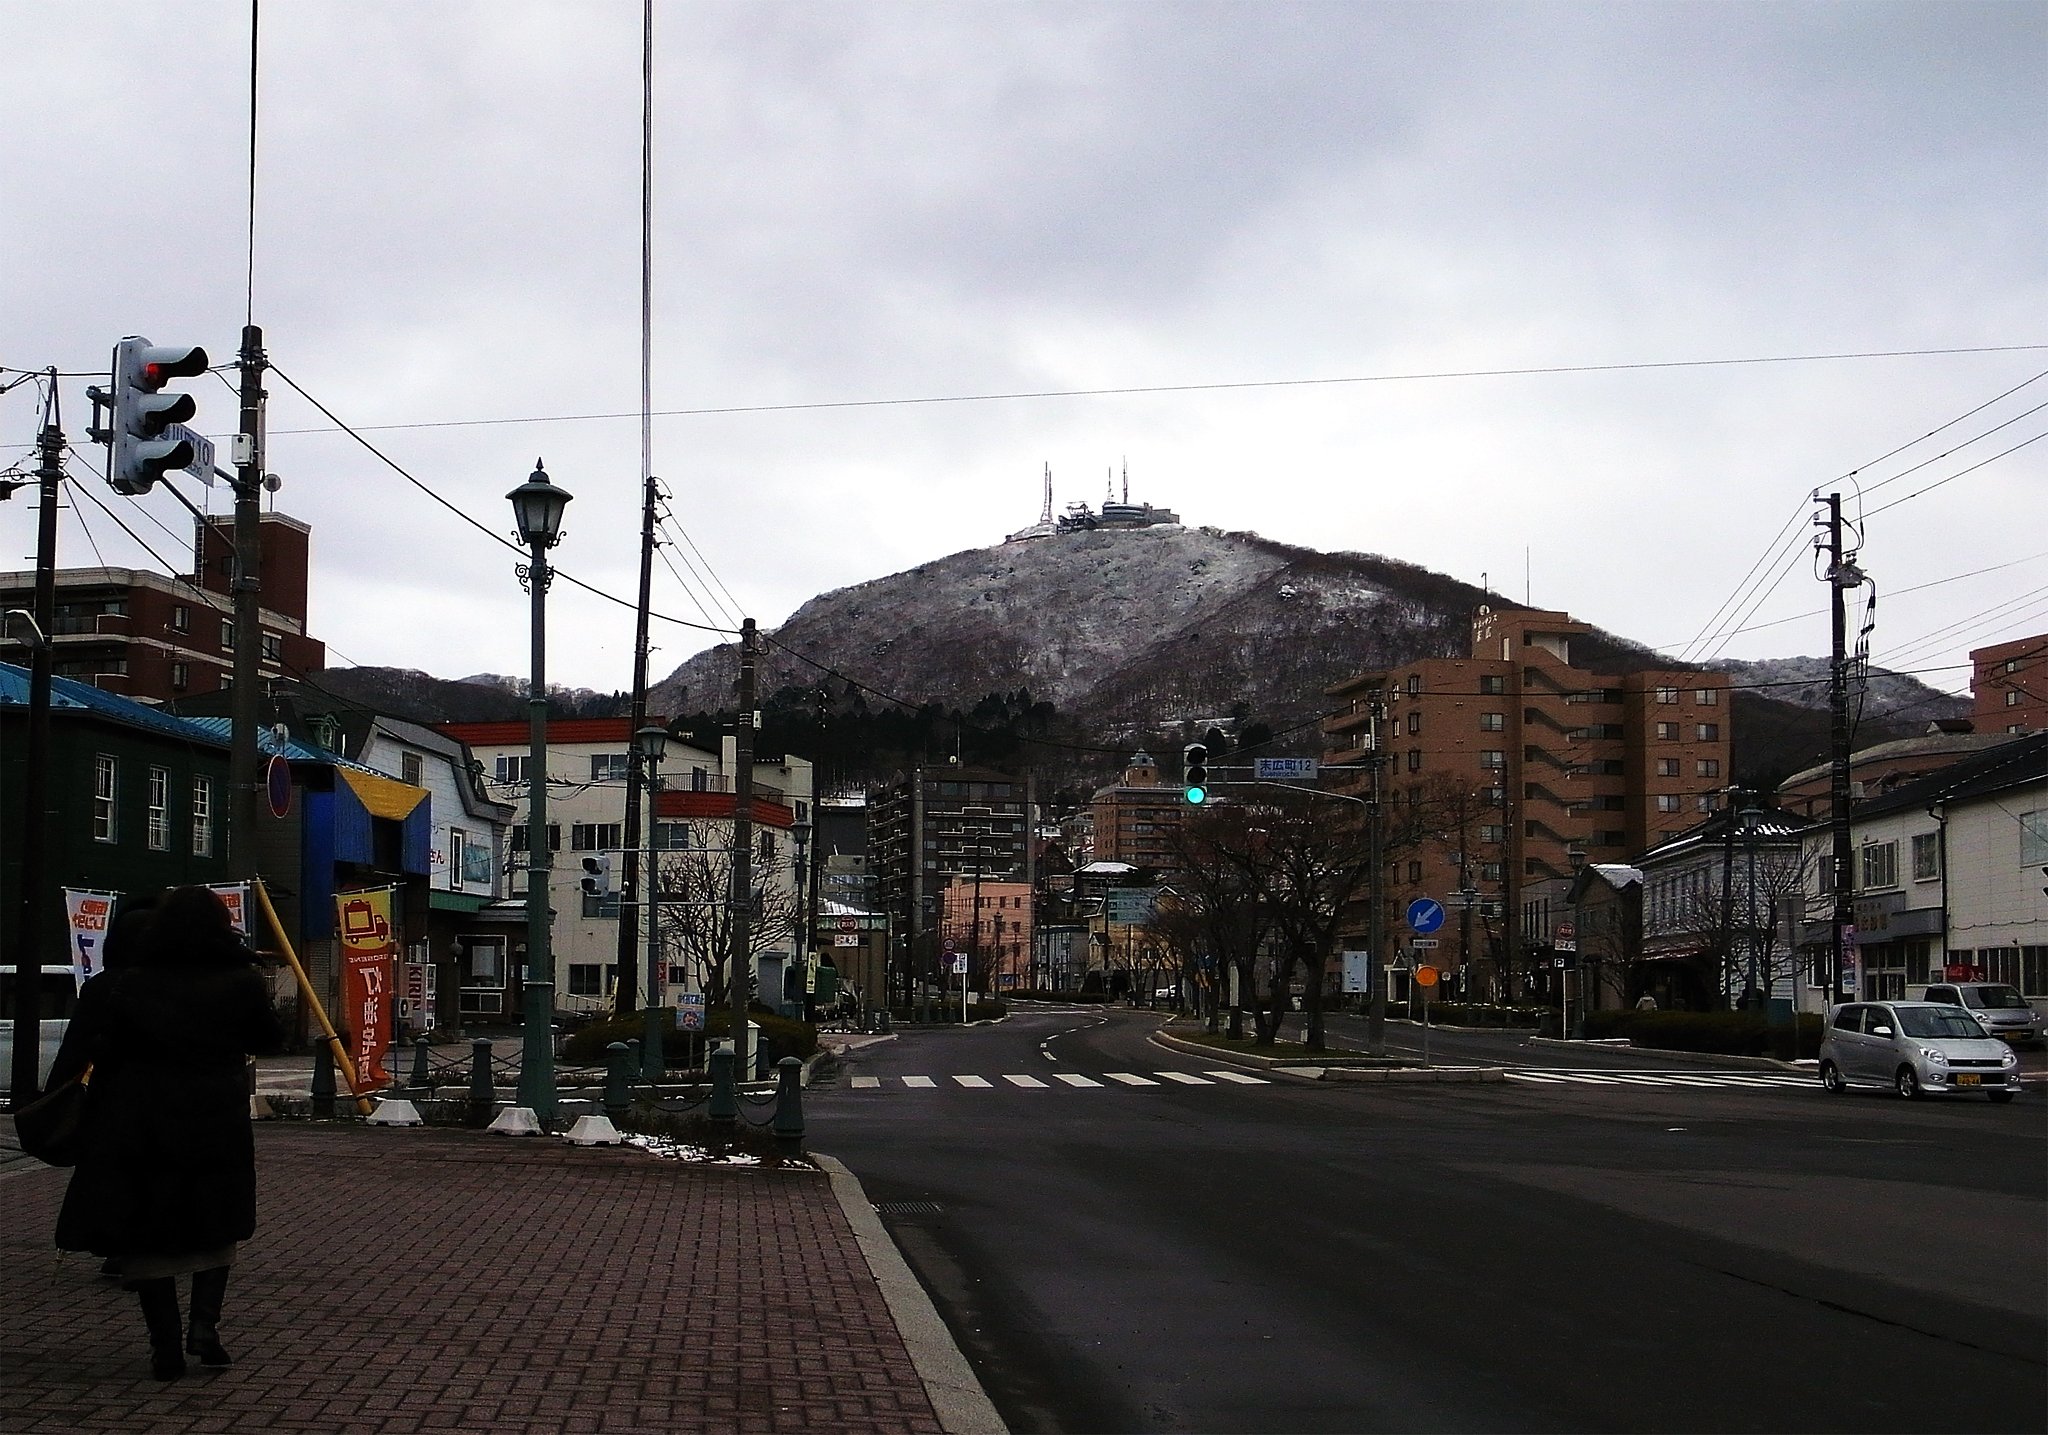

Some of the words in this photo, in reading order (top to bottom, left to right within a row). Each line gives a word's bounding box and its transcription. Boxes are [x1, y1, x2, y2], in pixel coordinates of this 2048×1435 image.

[1260, 759, 1311, 771] 末広町12
[409, 965, 423, 1011] KIRIN
